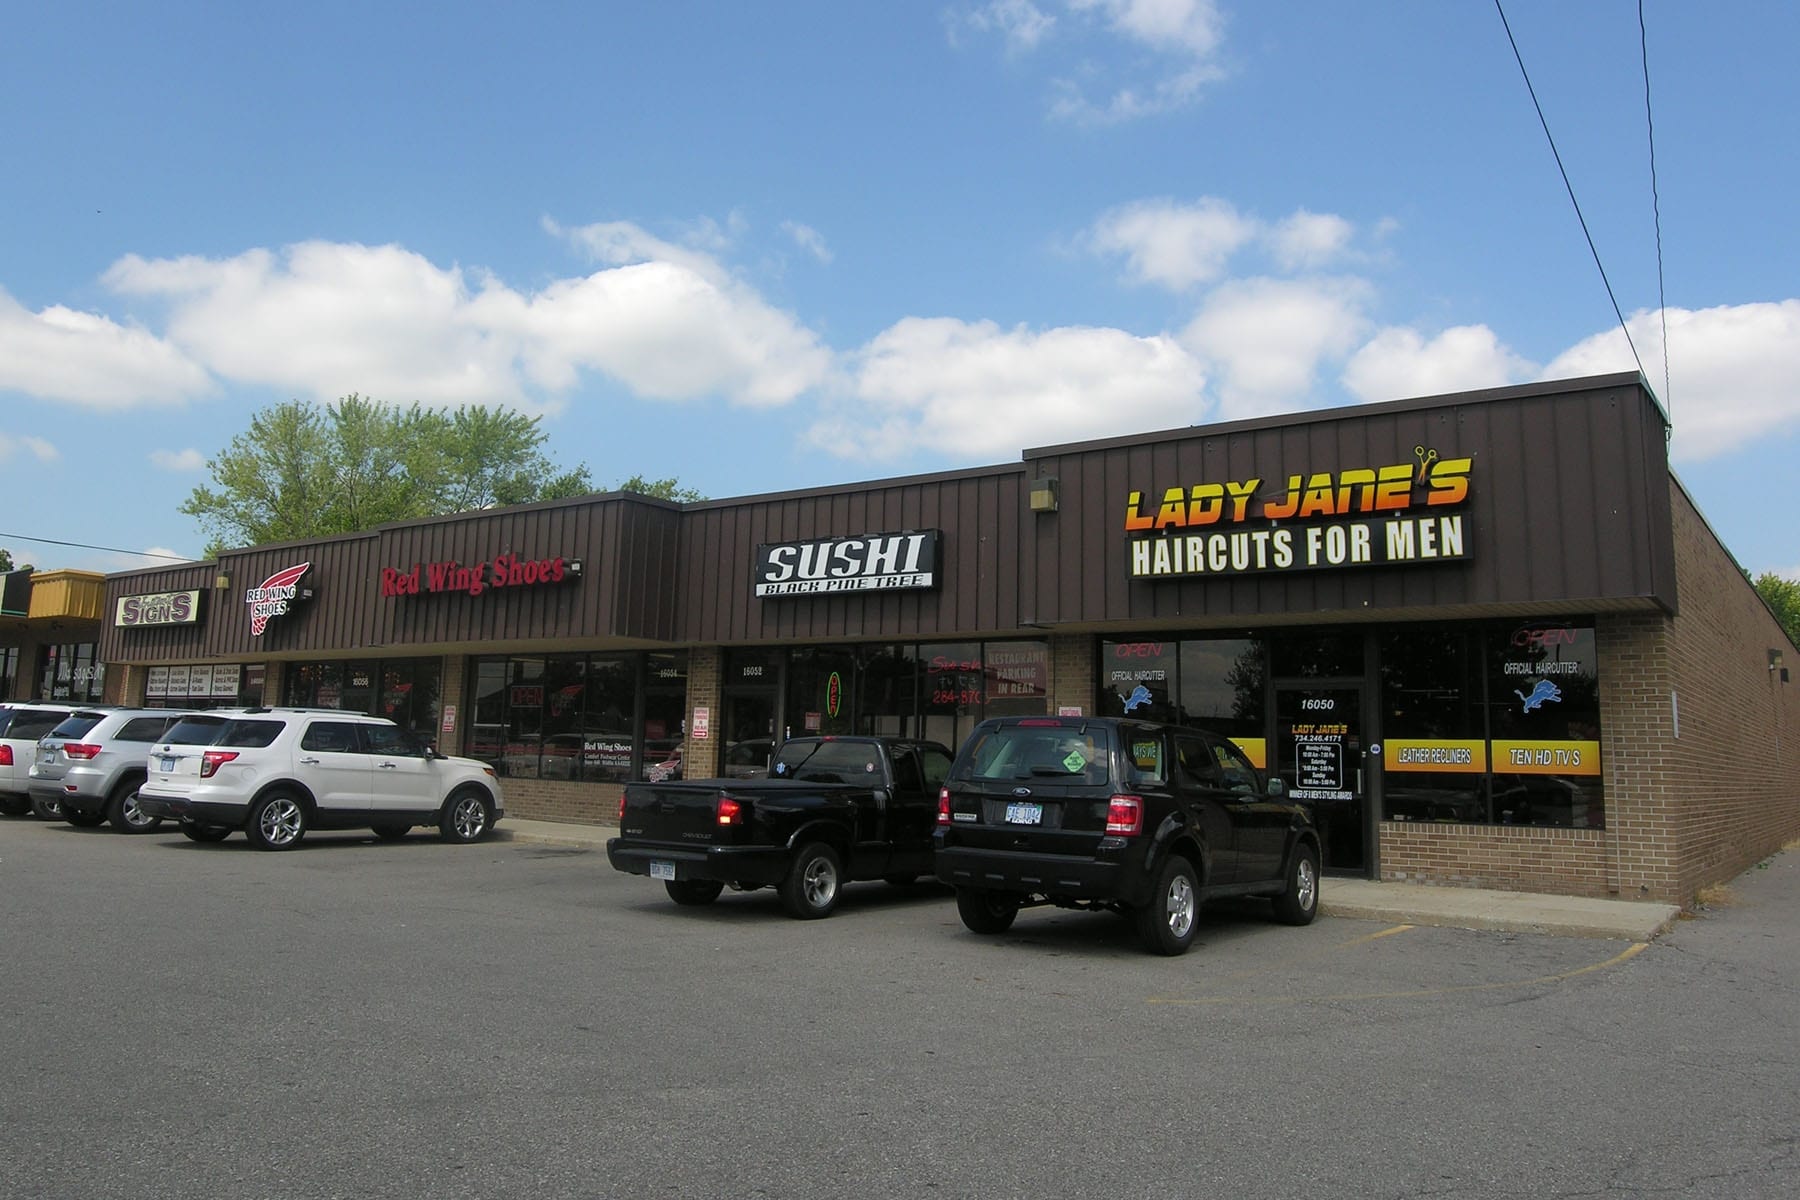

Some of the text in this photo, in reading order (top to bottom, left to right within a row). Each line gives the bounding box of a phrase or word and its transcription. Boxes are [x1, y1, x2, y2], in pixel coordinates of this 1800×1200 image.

[1125, 456, 1472, 532] LADY JANE'S
[1132, 515, 1464, 576] HAIRCUTS FOR MEN
[765, 535, 926, 582] SUSHI
[382, 552, 565, 597] Red Wing Shoes
[765, 574, 925, 595] BLACK PINE TREE
[247, 585, 296, 602] RED WING
[122, 592, 192, 625] SIGNS
[254, 601, 287, 616] SHOES
[1513, 629, 1577, 647] OPEN
[1115, 643, 1163, 658] OPEN
[997, 667, 1036, 680] PARKING
[1111, 670, 1166, 681] OFFICIAL HAIRCUTTER
[1504, 661, 1578, 675] OFFICIAL HAIRCUTTER
[829, 676, 838, 713] OPEN
[998, 682, 1035, 695] IN REAR
[1301, 699, 1335, 710] 16050
[1292, 724, 1315, 734] LADY
[584, 742, 632, 753] Red Wing Shoes
[1398, 748, 1471, 764] LEATHER RECLINERS
[1510, 749, 1534, 765] TEN
[1535, 749, 1552, 765] HD
[1555, 750, 1571, 766] TV
